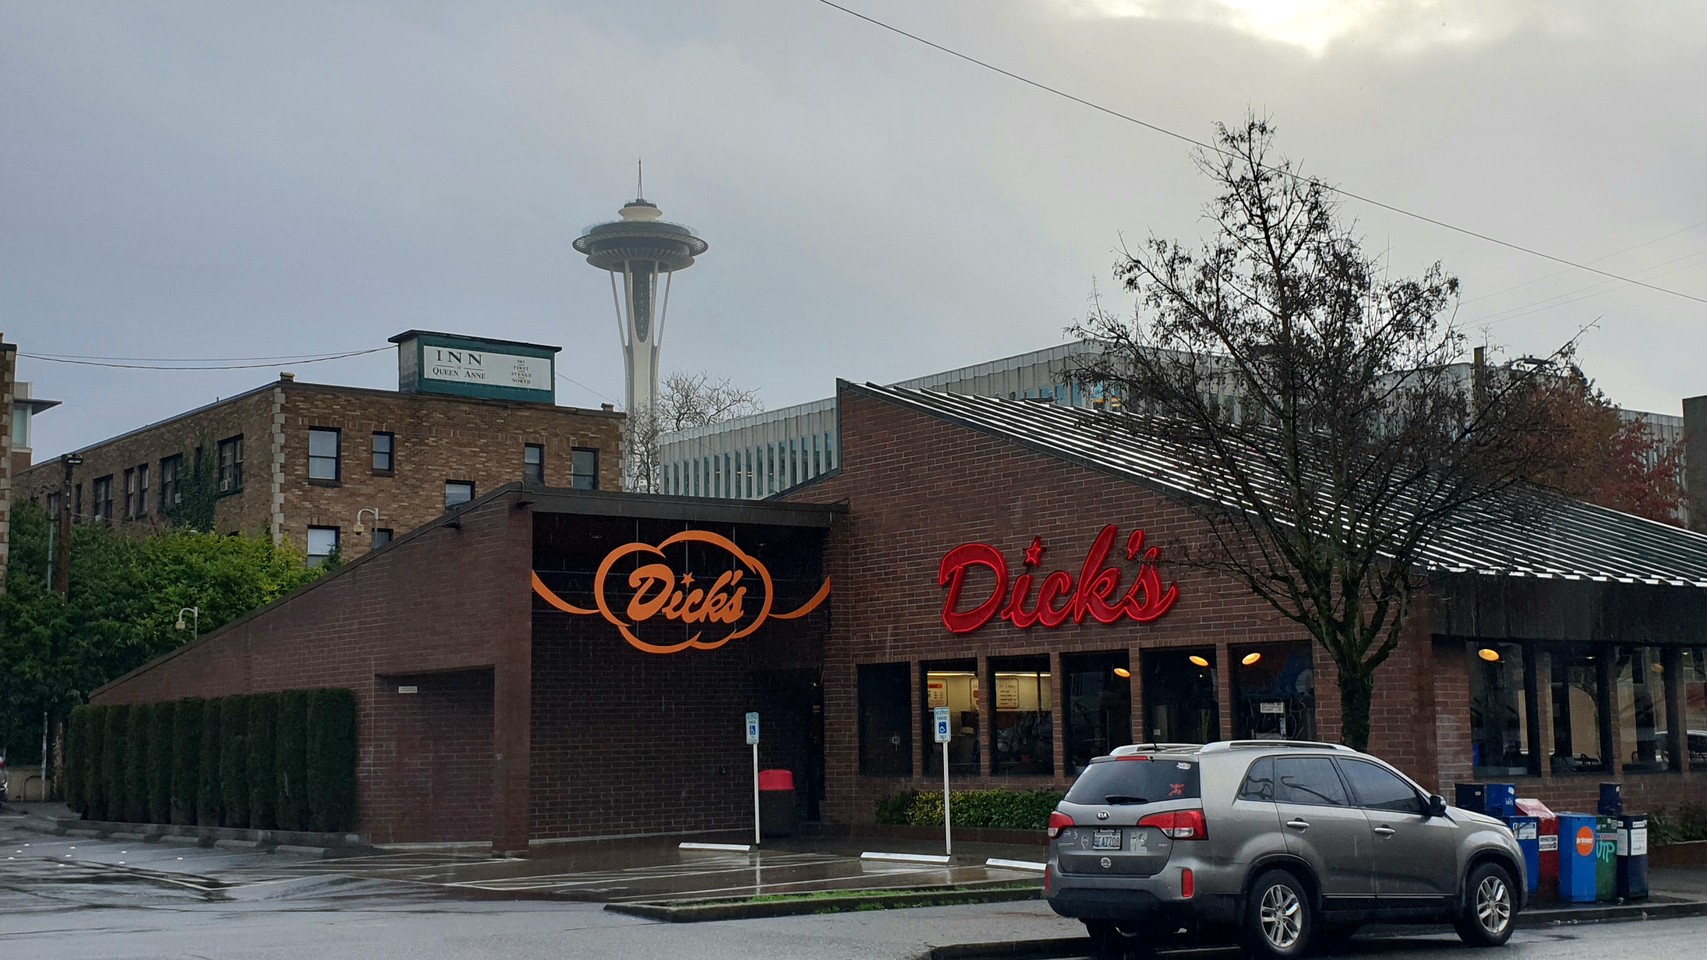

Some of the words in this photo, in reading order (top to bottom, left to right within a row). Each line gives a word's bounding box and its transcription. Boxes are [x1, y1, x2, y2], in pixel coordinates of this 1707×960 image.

[437, 350, 482, 366] INN
[432, 366, 459, 377] QUEEN
[464, 371, 486, 380] ANNE
[938, 524, 1179, 634] Dick's
[627, 563, 747, 623] Dick's
[1097, 810, 1108, 819] KIA
